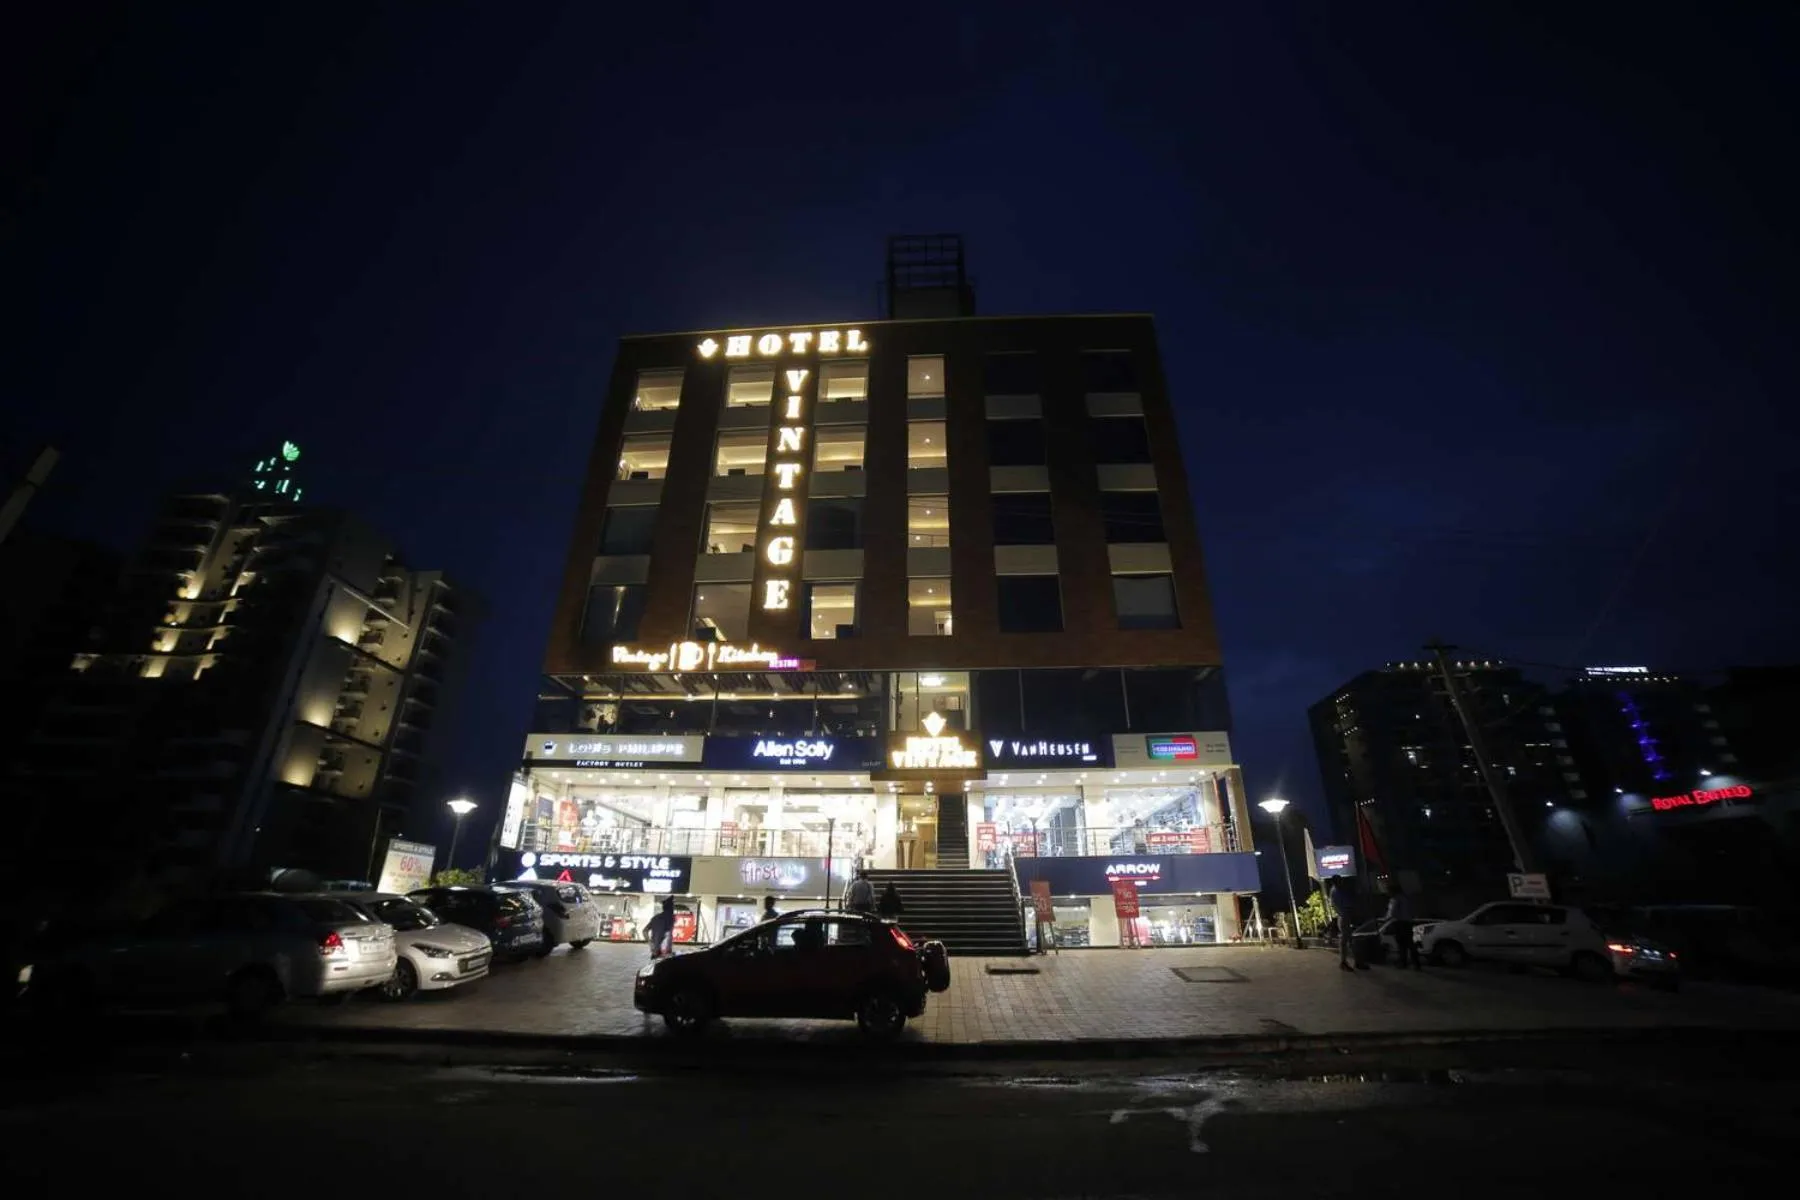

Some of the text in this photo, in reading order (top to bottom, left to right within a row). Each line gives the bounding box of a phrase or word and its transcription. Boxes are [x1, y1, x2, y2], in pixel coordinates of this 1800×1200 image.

[725, 329, 868, 357] HOTEL
[763, 368, 809, 610] VINTAGE
[753, 739, 834, 761] Allen Solly
[1651, 795, 1694, 810] ROYAL
[540, 853, 670, 870] SPORTS & STYLE
[1105, 863, 1160, 875] ARROW
